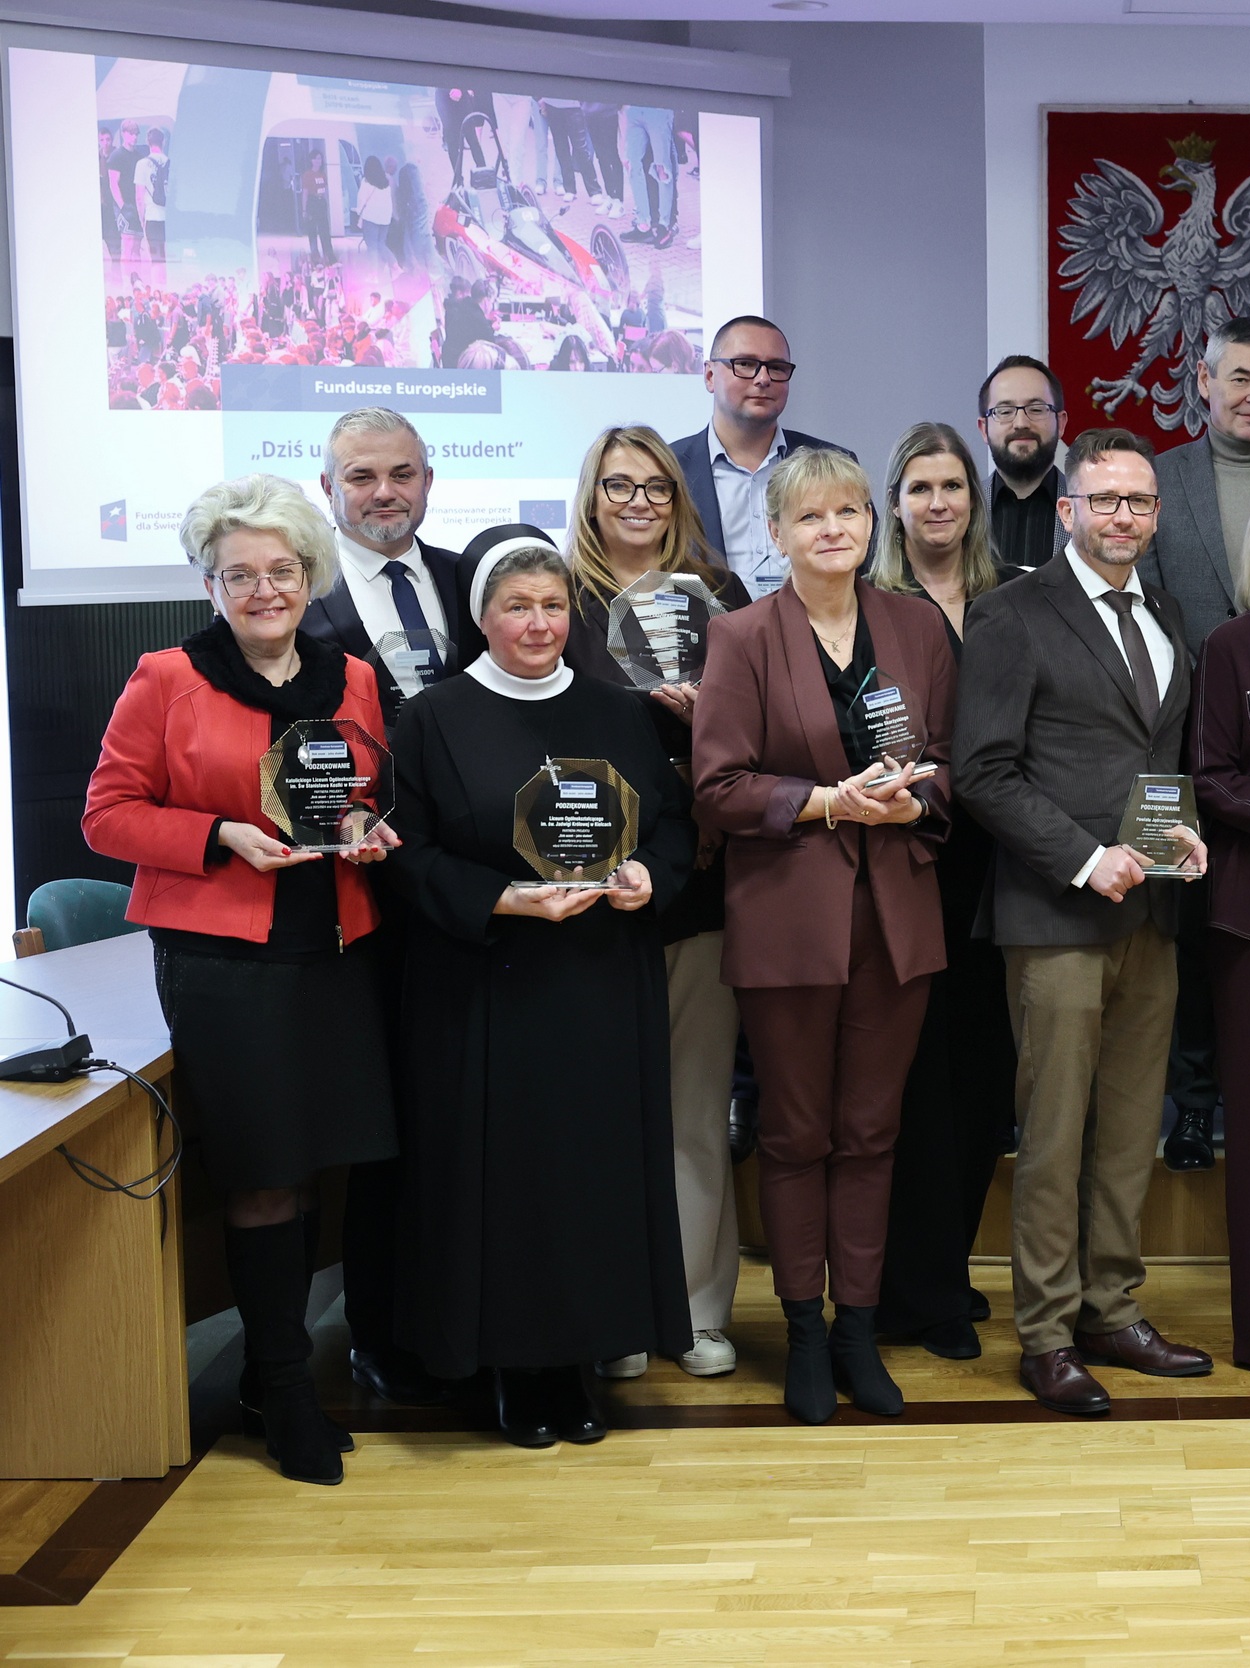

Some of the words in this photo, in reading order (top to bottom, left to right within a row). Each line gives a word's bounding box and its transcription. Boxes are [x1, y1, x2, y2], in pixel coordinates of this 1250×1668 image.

[315, 380, 393, 395] Fundusze
[396, 382, 487, 399] Europejskie
[135, 511, 183, 519] Fundusze
[425, 507, 487, 516] ofinansowane
[136, 522, 151, 531] dla
